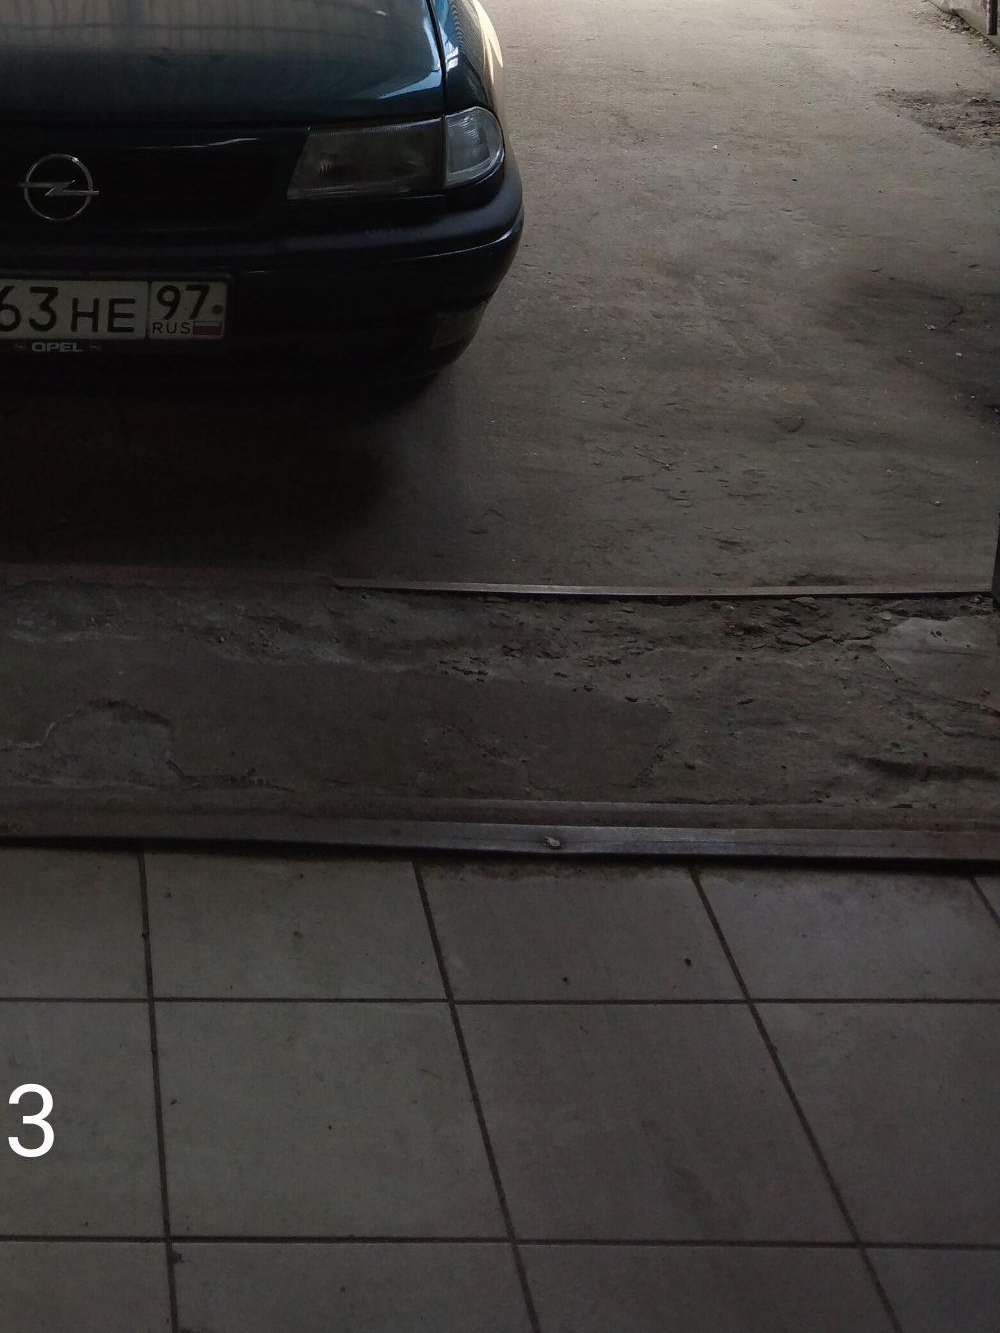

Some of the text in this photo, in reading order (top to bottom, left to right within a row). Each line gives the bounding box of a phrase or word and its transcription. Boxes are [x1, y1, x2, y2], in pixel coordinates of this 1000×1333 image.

[156, 284, 211, 320] 97
[151, 322, 192, 335] RUS
[31, 342, 85, 354] OPEL
